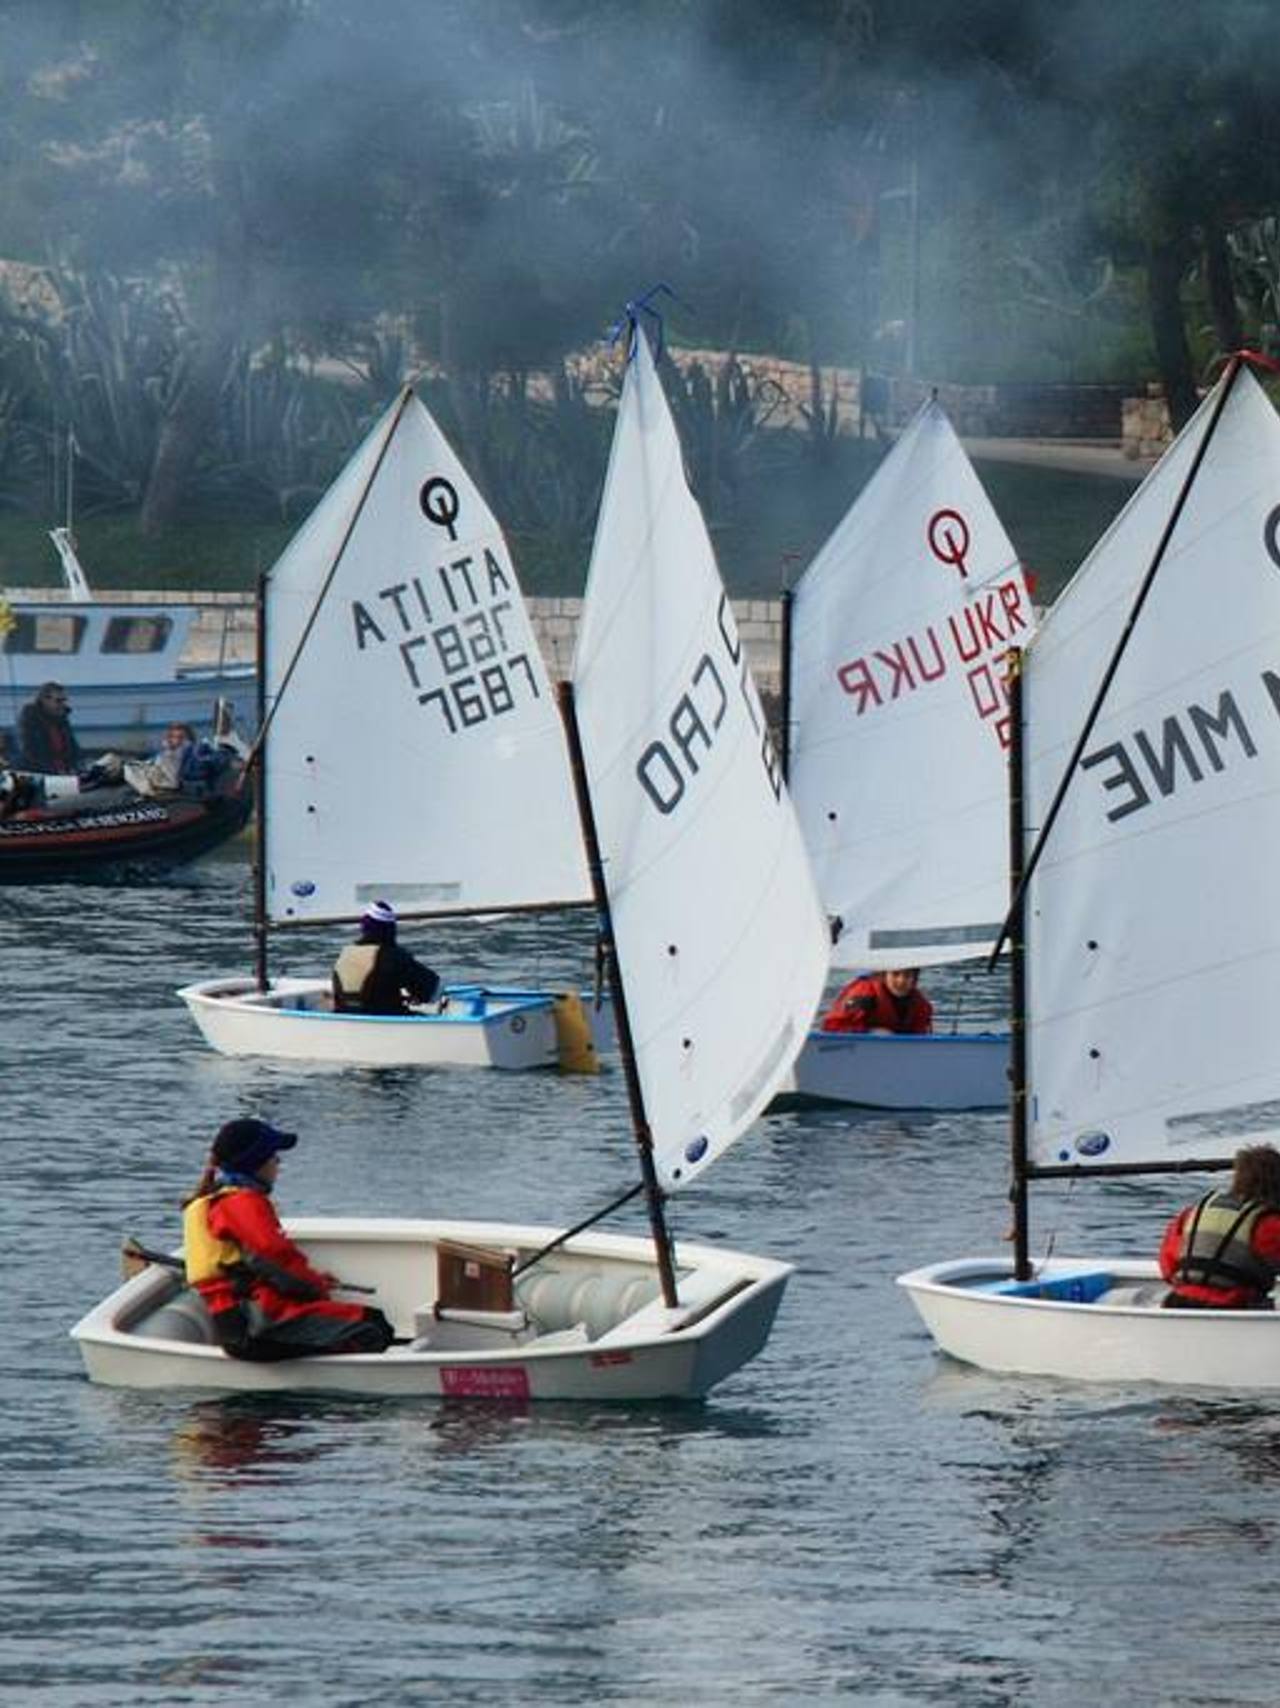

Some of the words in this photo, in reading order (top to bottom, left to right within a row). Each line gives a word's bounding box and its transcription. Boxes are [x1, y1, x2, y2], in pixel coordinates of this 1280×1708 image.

[438, 547, 511, 613] ITA
[947, 580, 1027, 663] UKR
[417, 652, 541, 734] 7687
